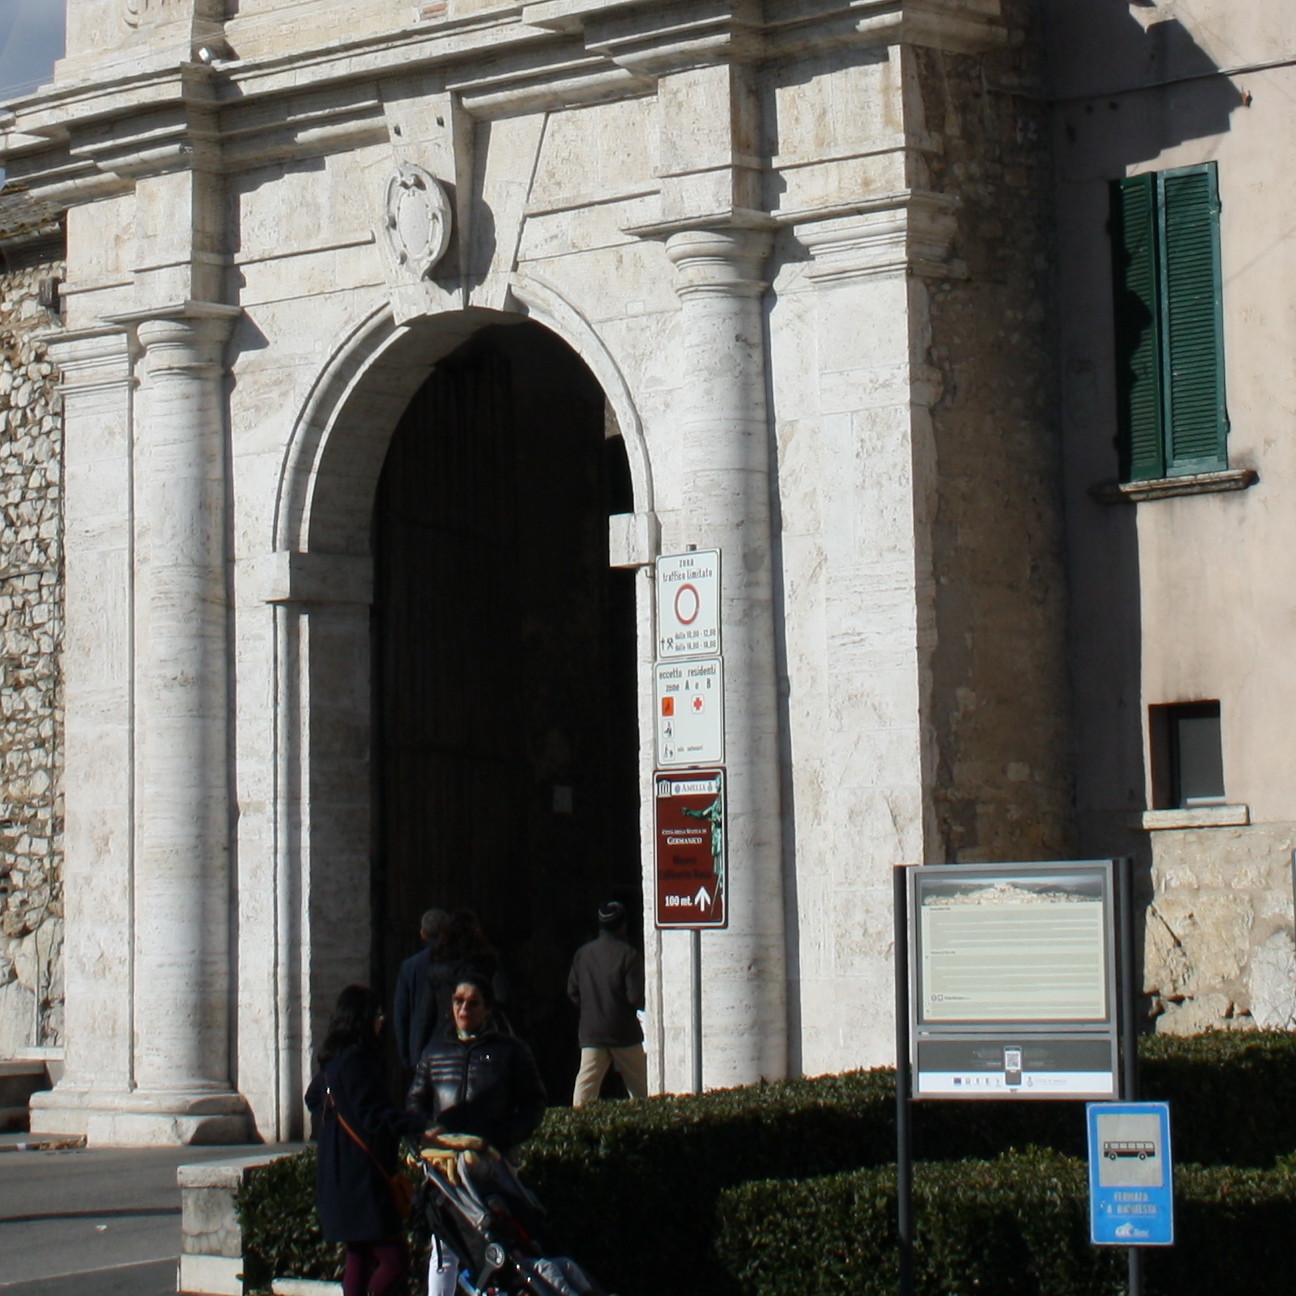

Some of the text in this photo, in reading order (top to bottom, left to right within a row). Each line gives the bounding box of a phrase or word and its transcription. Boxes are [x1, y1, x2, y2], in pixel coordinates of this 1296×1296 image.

[679, 558, 694, 568] zona
[662, 567, 713, 582] traffico limitato
[659, 663, 716, 680] eccetto residenti
[685, 679, 690, 691] A
[706, 678, 711, 689] B
[665, 895, 679, 907] 100
